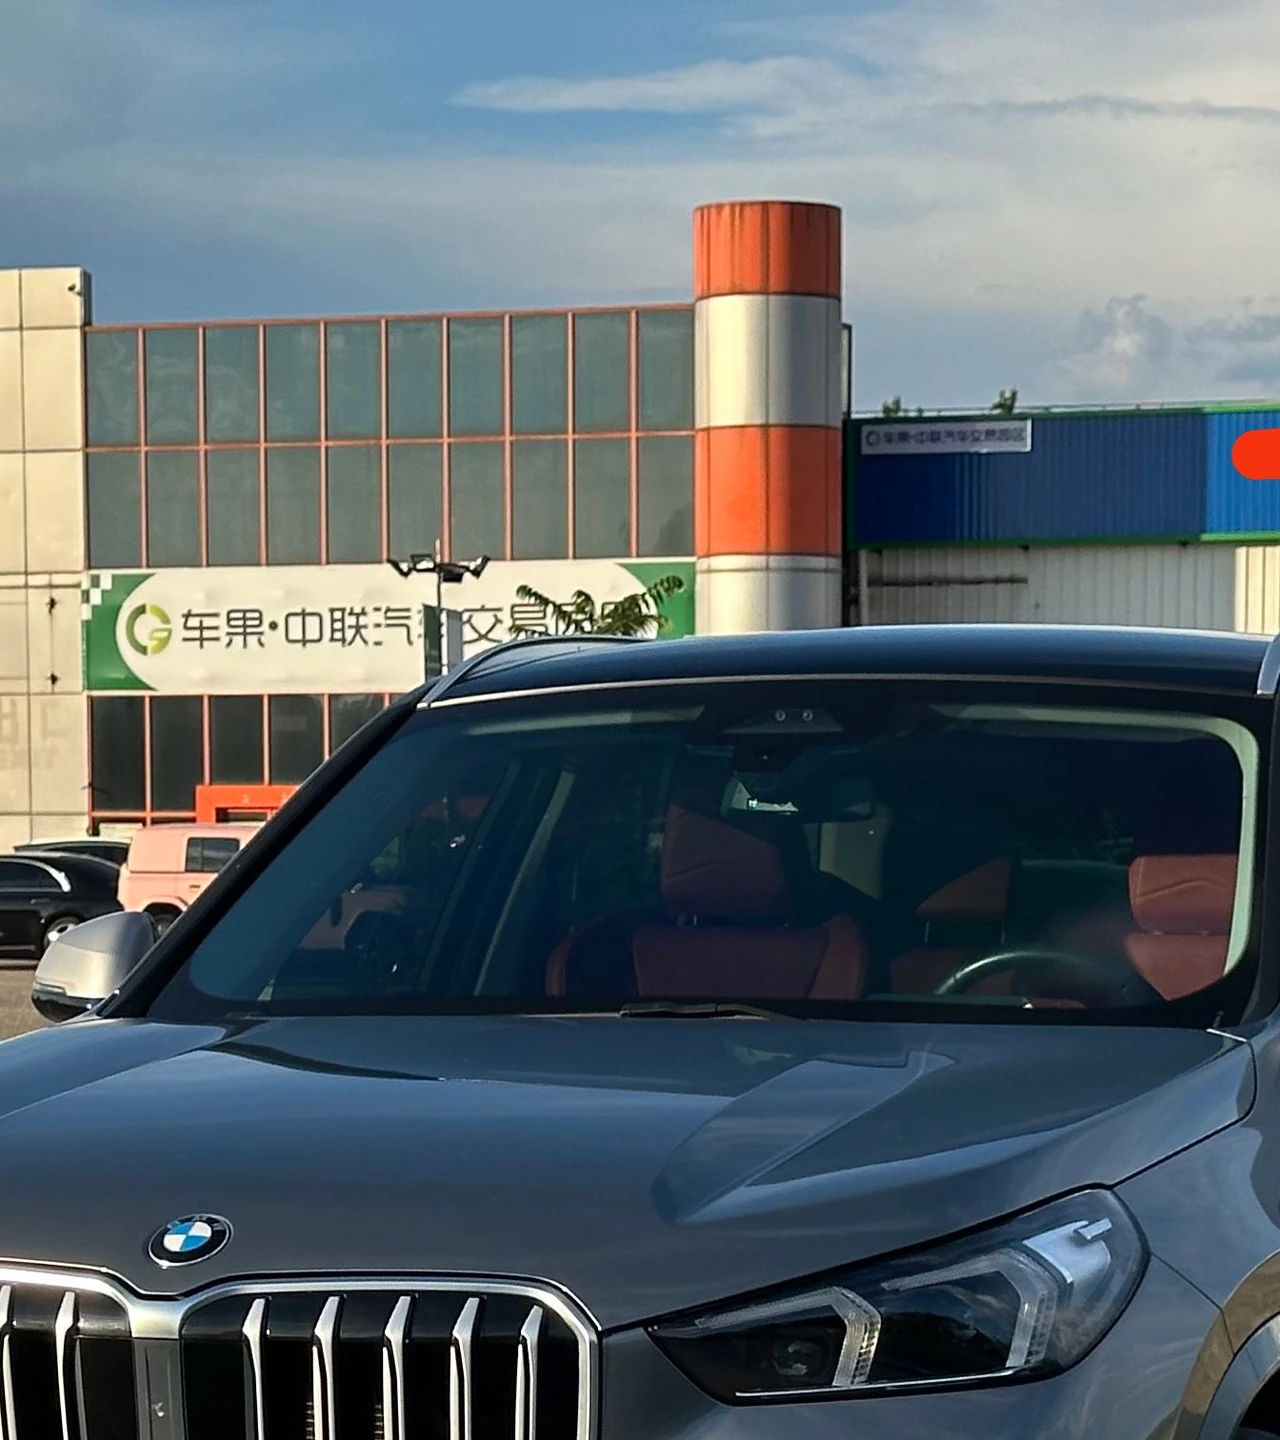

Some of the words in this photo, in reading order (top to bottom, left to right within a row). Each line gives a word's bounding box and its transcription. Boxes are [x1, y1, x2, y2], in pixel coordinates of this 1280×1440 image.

[182, 602, 646, 649] 车果·中联汽交易
